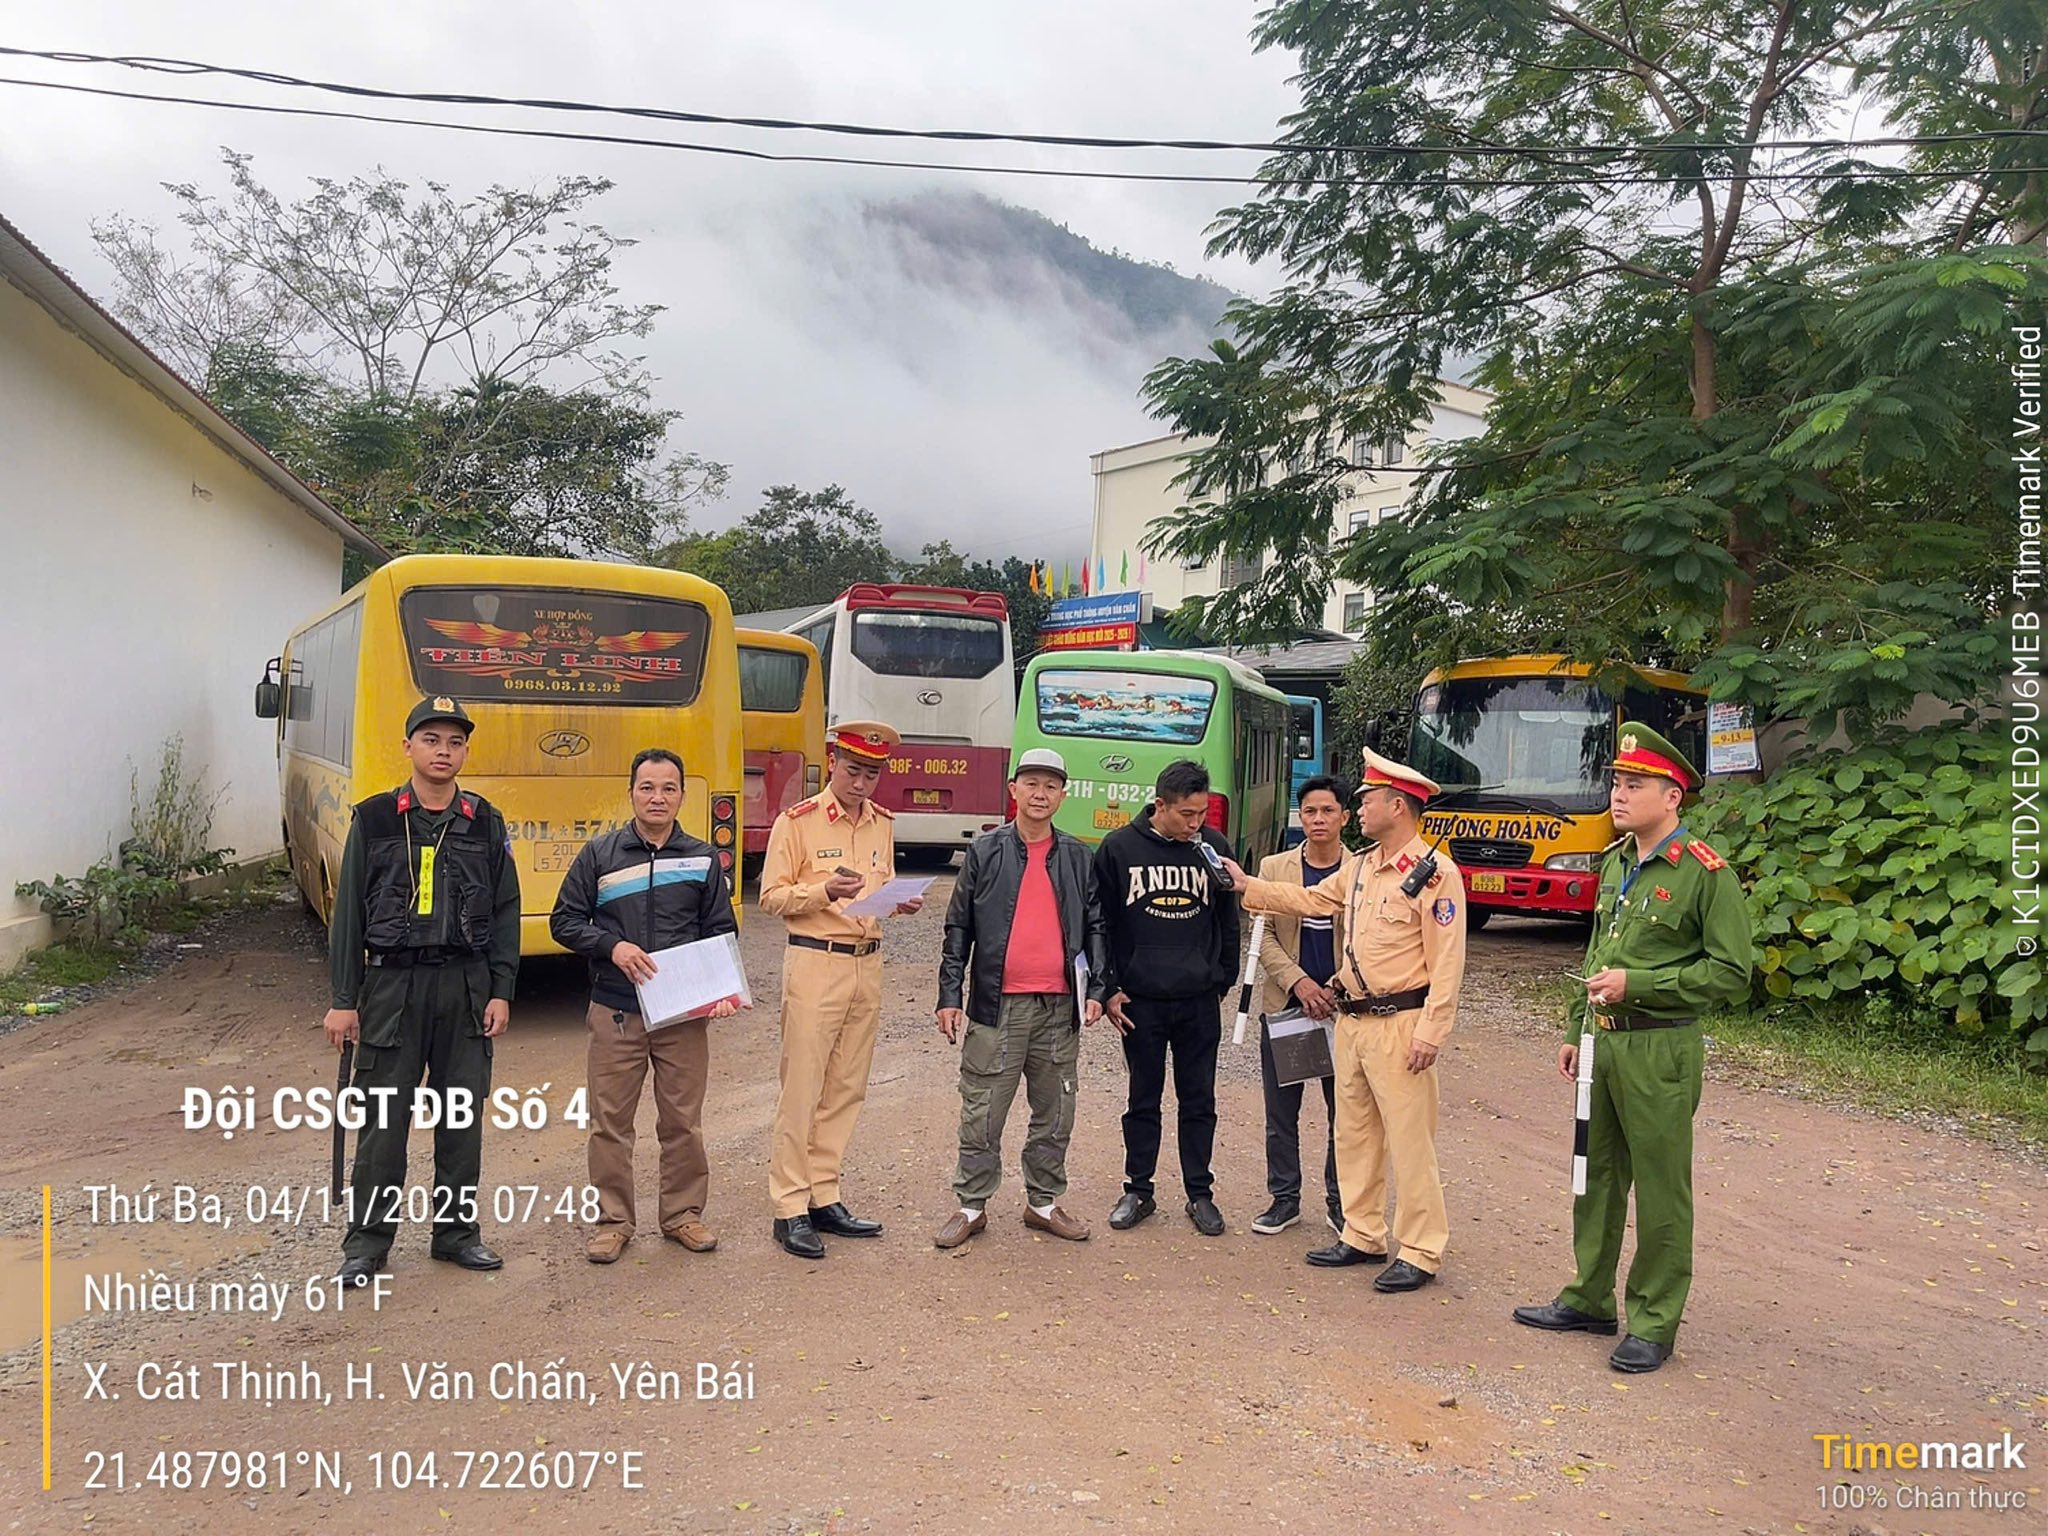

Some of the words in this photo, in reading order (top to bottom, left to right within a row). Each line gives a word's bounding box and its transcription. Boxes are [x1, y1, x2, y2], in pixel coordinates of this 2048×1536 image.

[535, 610, 546, 620] XE
[547, 609, 567, 621] HỢP
[568, 608, 593, 621] ĐỒNG
[561, 653, 682, 671] LINH
[504, 678, 622, 693] 0968.03.12.92
[889, 758, 913, 774] 98F
[924, 759, 968, 775] 006.32
